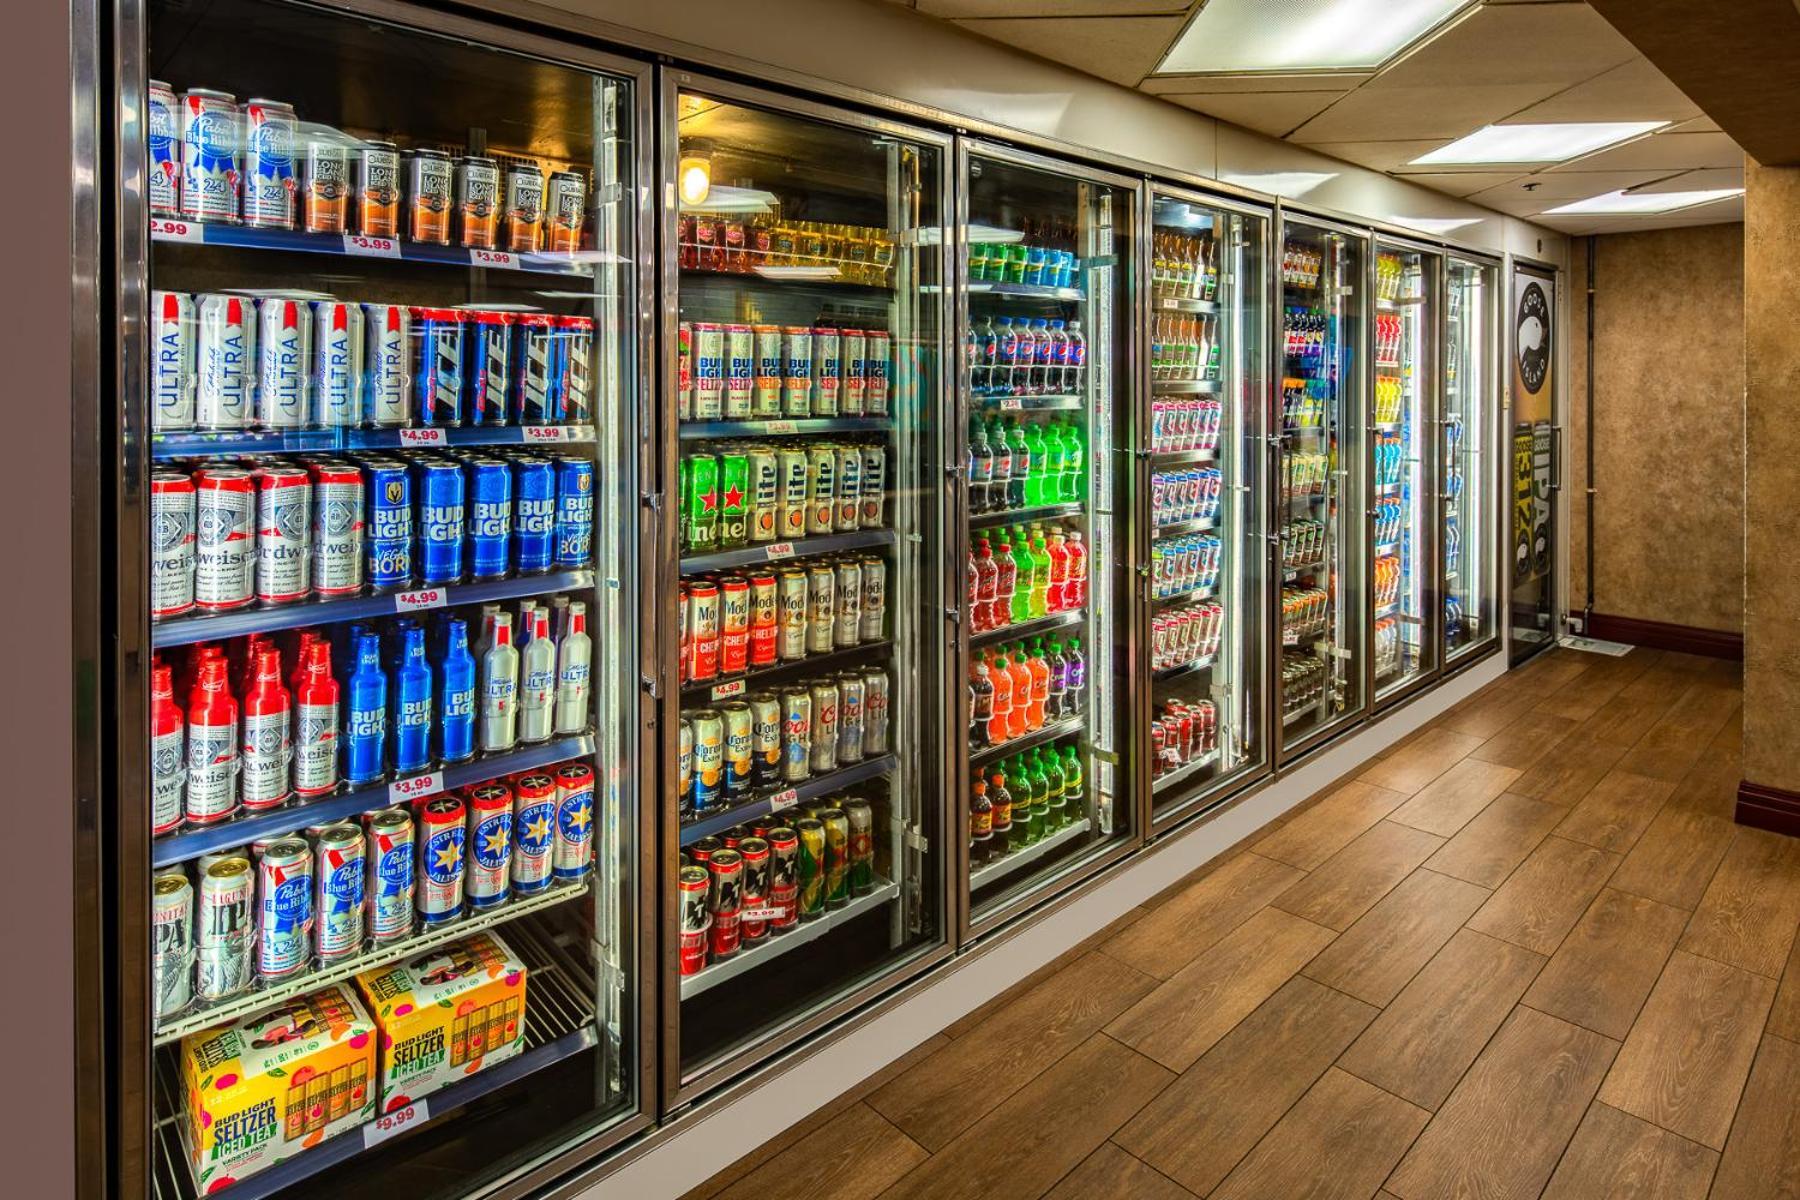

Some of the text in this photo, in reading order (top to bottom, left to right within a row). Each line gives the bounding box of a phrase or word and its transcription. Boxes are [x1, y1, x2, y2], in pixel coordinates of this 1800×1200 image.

[203, 177, 226, 193] 24
[263, 186, 285, 199] 24
[351, 236, 393, 251] $3.99
[476, 251, 511, 264] $3.99
[159, 332, 180, 408] ULTRA
[223, 335, 243, 408] ULTRA
[280, 336, 298, 407] ULTRA
[330, 337, 348, 406] ULTRA
[386, 339, 401, 405] ULTRA
[401, 430, 439, 441] $4.99
[527, 427, 560, 438] $3.99
[1518, 455, 1532, 528] 312
[1534, 453, 1550, 530] IPA
[375, 508, 411, 525] BUD
[421, 506, 464, 525] BUD
[474, 502, 511, 520] BUD
[518, 499, 555, 516] BUD
[400, 591, 438, 604] $4.99
[715, 682, 740, 696] $4.99
[351, 708, 385, 724] BUD
[395, 776, 433, 794] $3.99
[394, 1026, 445, 1051] BUD LIGHT
[393, 1034, 445, 1067] SELTZER
[214, 1096, 276, 1129] BUD LIGHT
[375, 1106, 415, 1130] $9.99
[213, 1105, 277, 1147] SELTZER
[217, 1128, 272, 1158] ICED TEA
